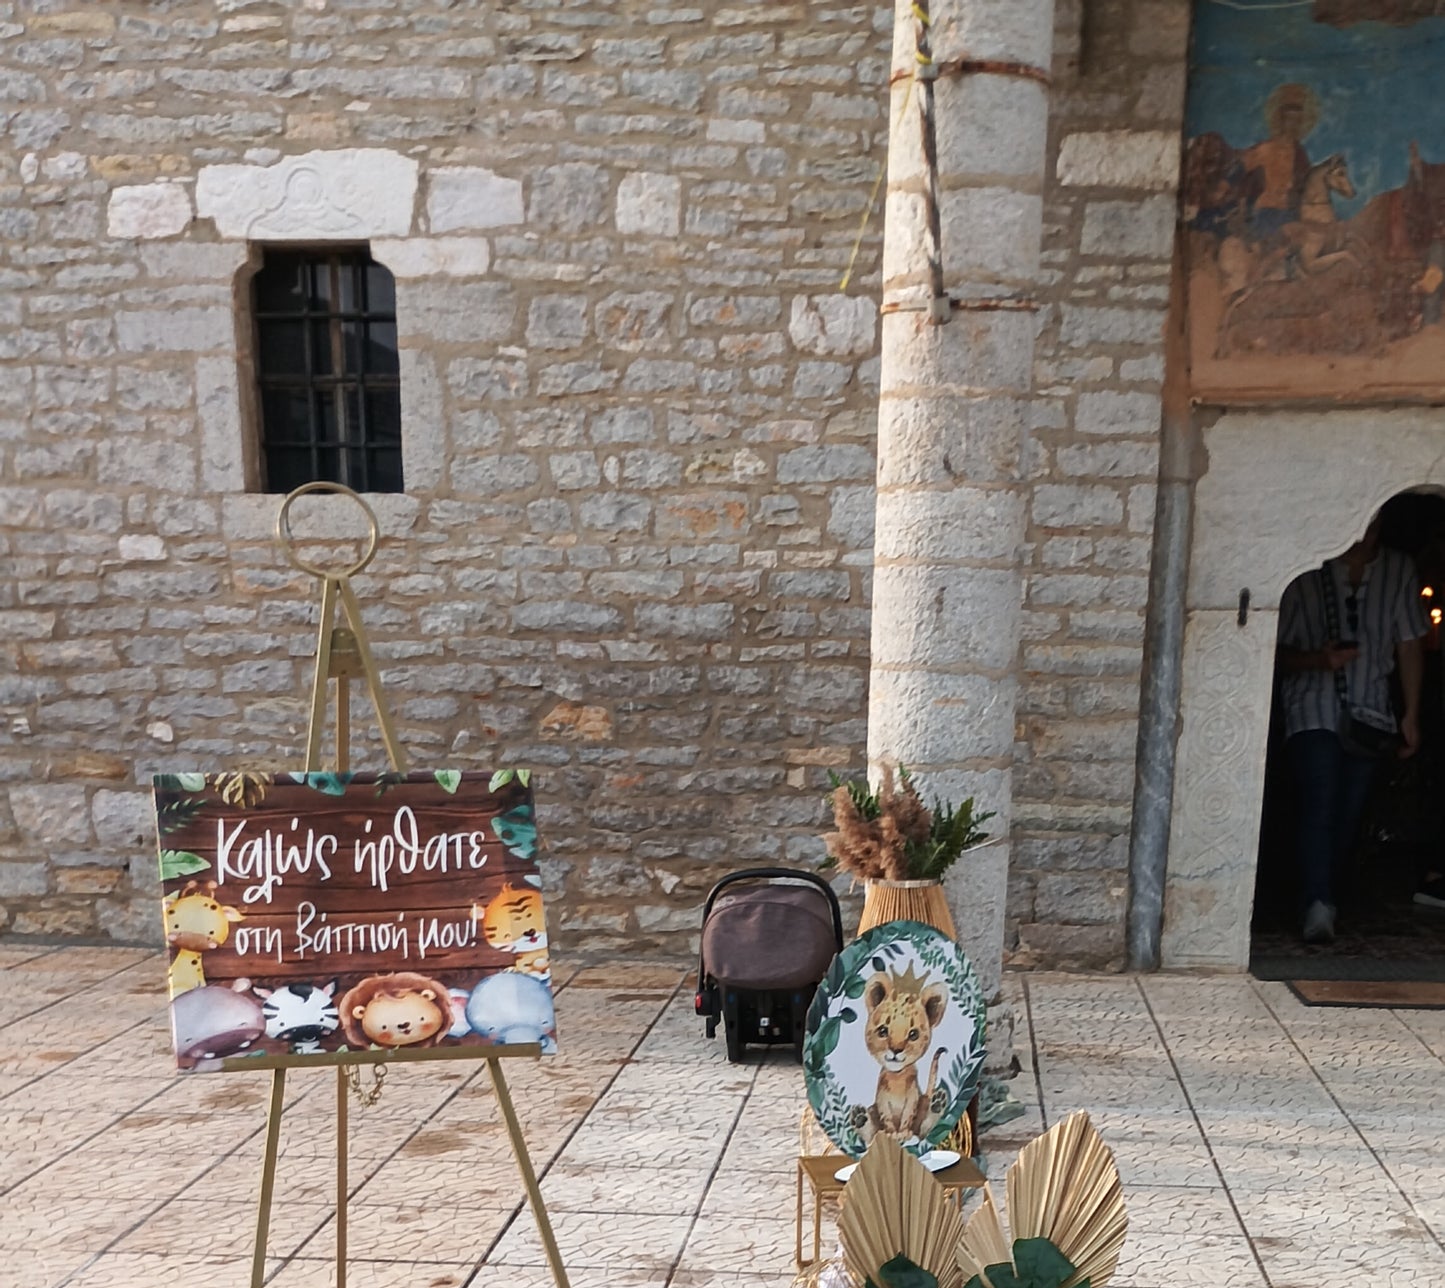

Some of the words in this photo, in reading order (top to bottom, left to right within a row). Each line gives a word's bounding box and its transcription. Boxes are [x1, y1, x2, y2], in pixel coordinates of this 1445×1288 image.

[216, 818, 338, 904] Καλώς
[354, 806, 488, 892] ήρθατε
[234, 926, 282, 963] στη
[293, 901, 409, 959] βάπτισή
[418, 903, 478, 959] μου!
